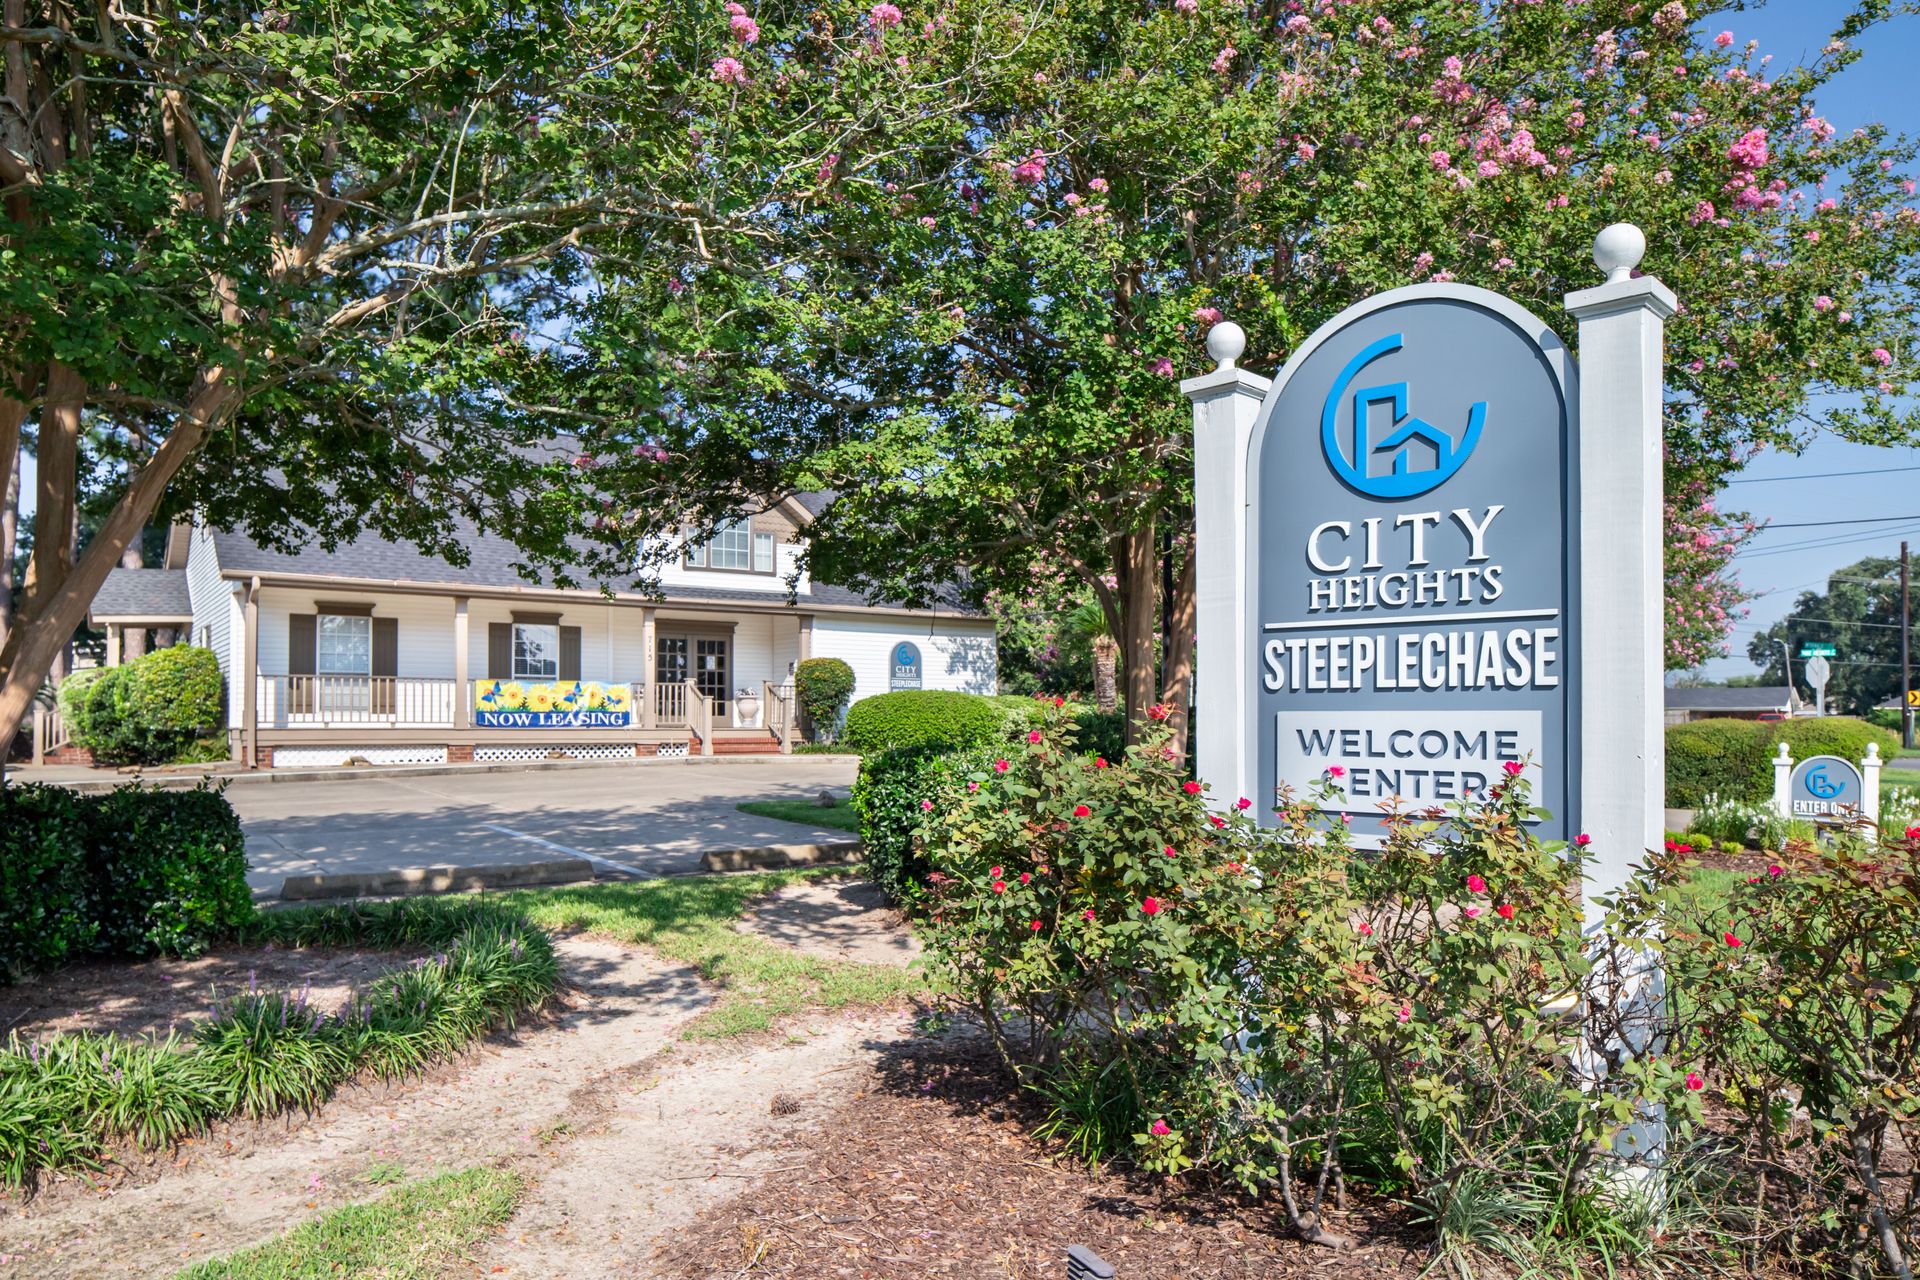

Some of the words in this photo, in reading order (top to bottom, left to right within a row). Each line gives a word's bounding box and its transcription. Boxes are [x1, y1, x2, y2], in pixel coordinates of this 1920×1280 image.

[1307, 505, 1504, 573] CITY
[1308, 565, 1504, 611] HEIGHTS
[895, 665, 916, 673] CITY
[1264, 627, 1559, 692] STEEPLECHASE
[483, 712, 533, 727] NOW
[539, 711, 624, 726] LEASING
[1296, 729, 1519, 761] WELCOME
[1794, 800, 1827, 813] ENTER
